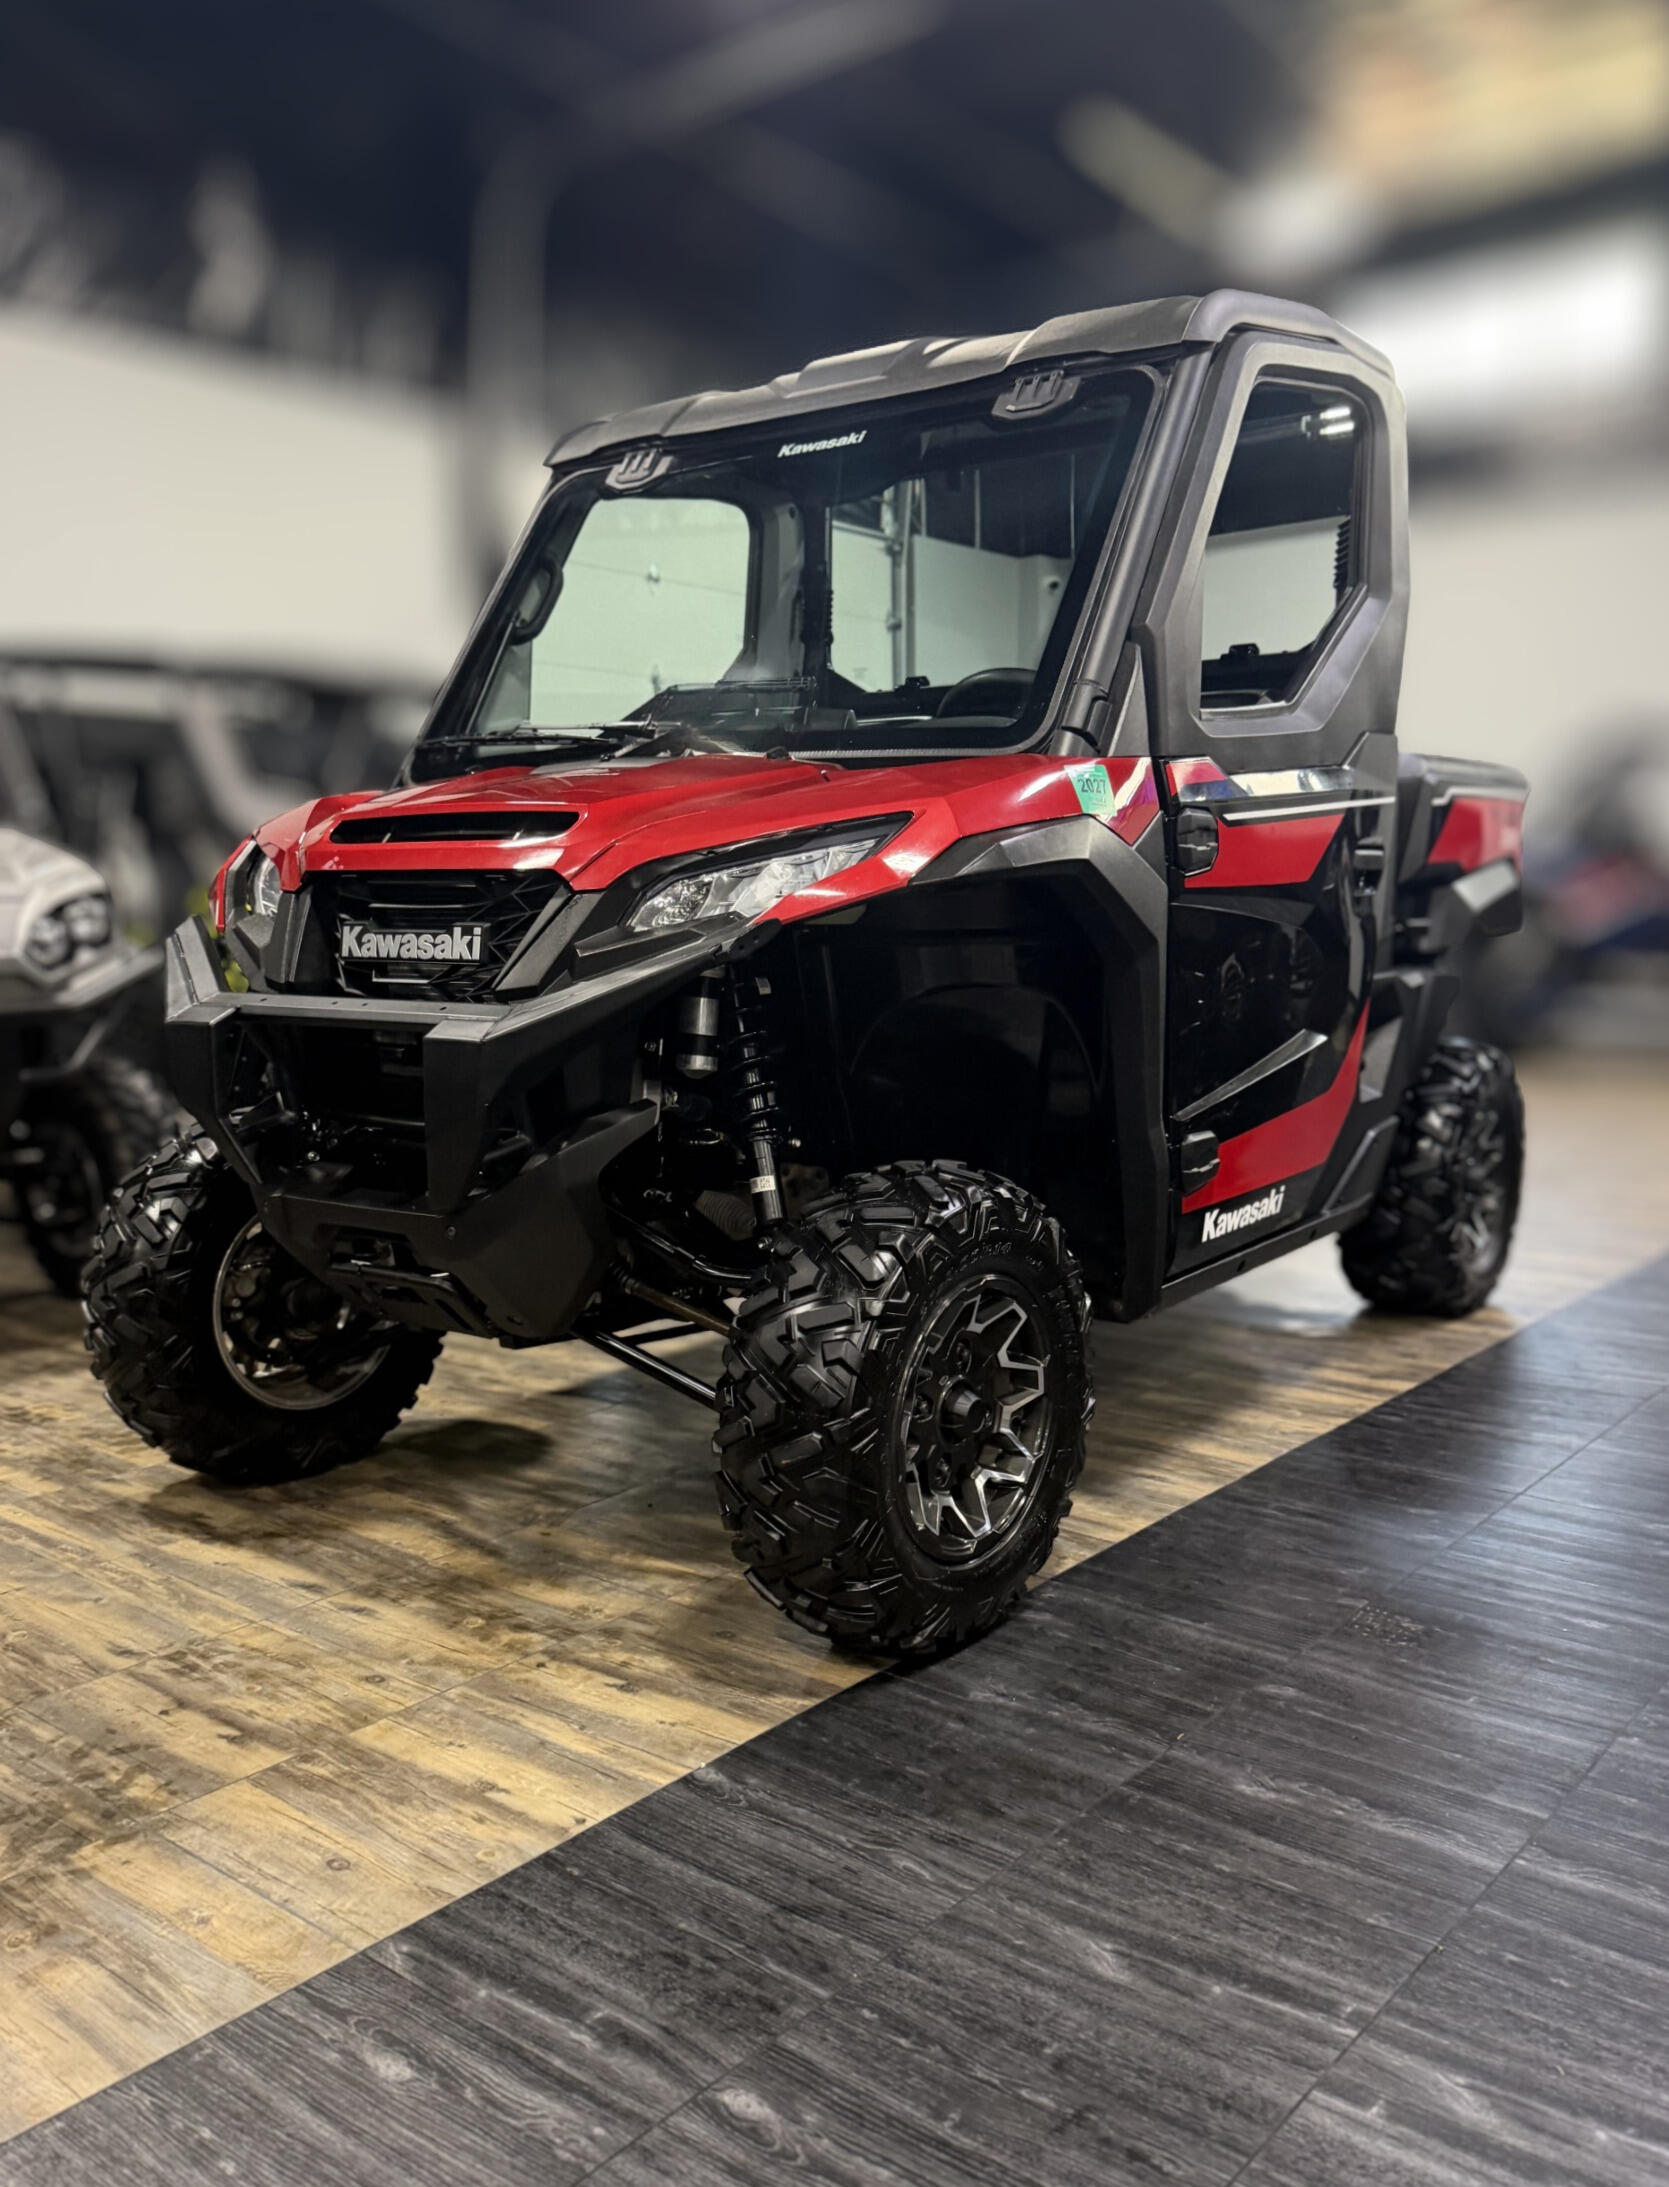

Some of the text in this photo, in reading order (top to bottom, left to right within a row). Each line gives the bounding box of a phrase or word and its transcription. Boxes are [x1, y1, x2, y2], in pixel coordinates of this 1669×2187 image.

[777, 430, 867, 458] Kawasaki
[1077, 778, 1106, 794] 2027
[341, 925, 482, 961] Kawasaki
[1201, 1184, 1286, 1243] Kawasaki
